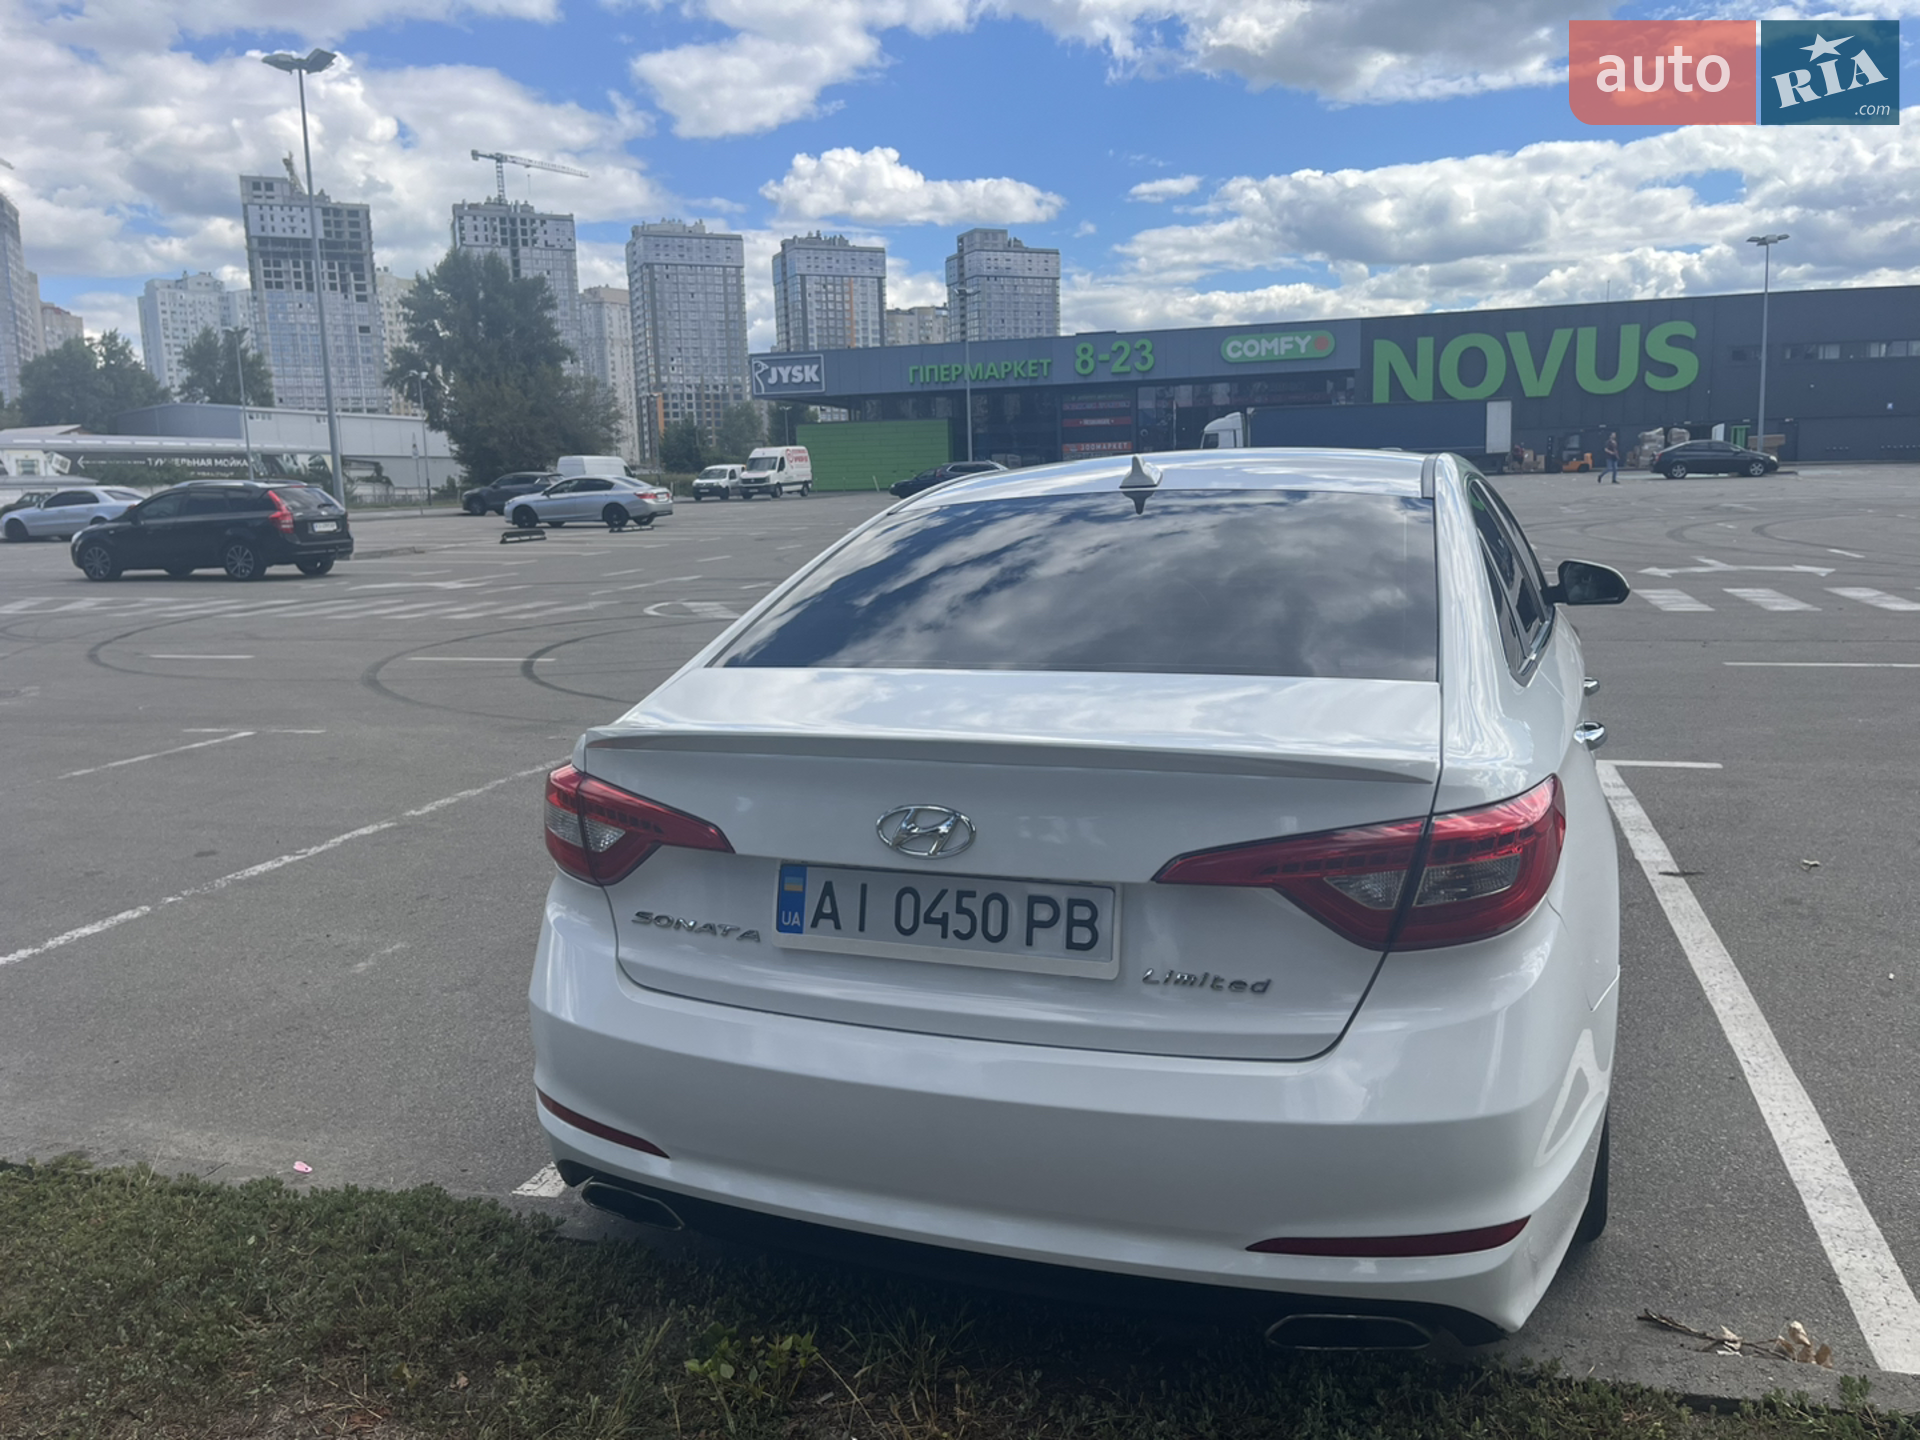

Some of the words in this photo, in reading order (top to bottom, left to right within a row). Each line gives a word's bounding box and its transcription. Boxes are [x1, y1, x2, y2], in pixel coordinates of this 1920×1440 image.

[908, 359, 1052, 384] ГІПЕРМАРКЕТ
[1075, 338, 1156, 376] 8-23
[1226, 335, 1312, 359] COMFY
[767, 364, 821, 385] JYSK
[1372, 320, 1699, 404] NOVUS
[214, 456, 249, 468] МОЙКА
[631, 911, 761, 943] SONATA
[781, 910, 801, 927] UA
[809, 880, 868, 933] AI
[894, 886, 1009, 943] 0450
[1025, 894, 1099, 951] PB
[1142, 967, 1272, 995] Limited
